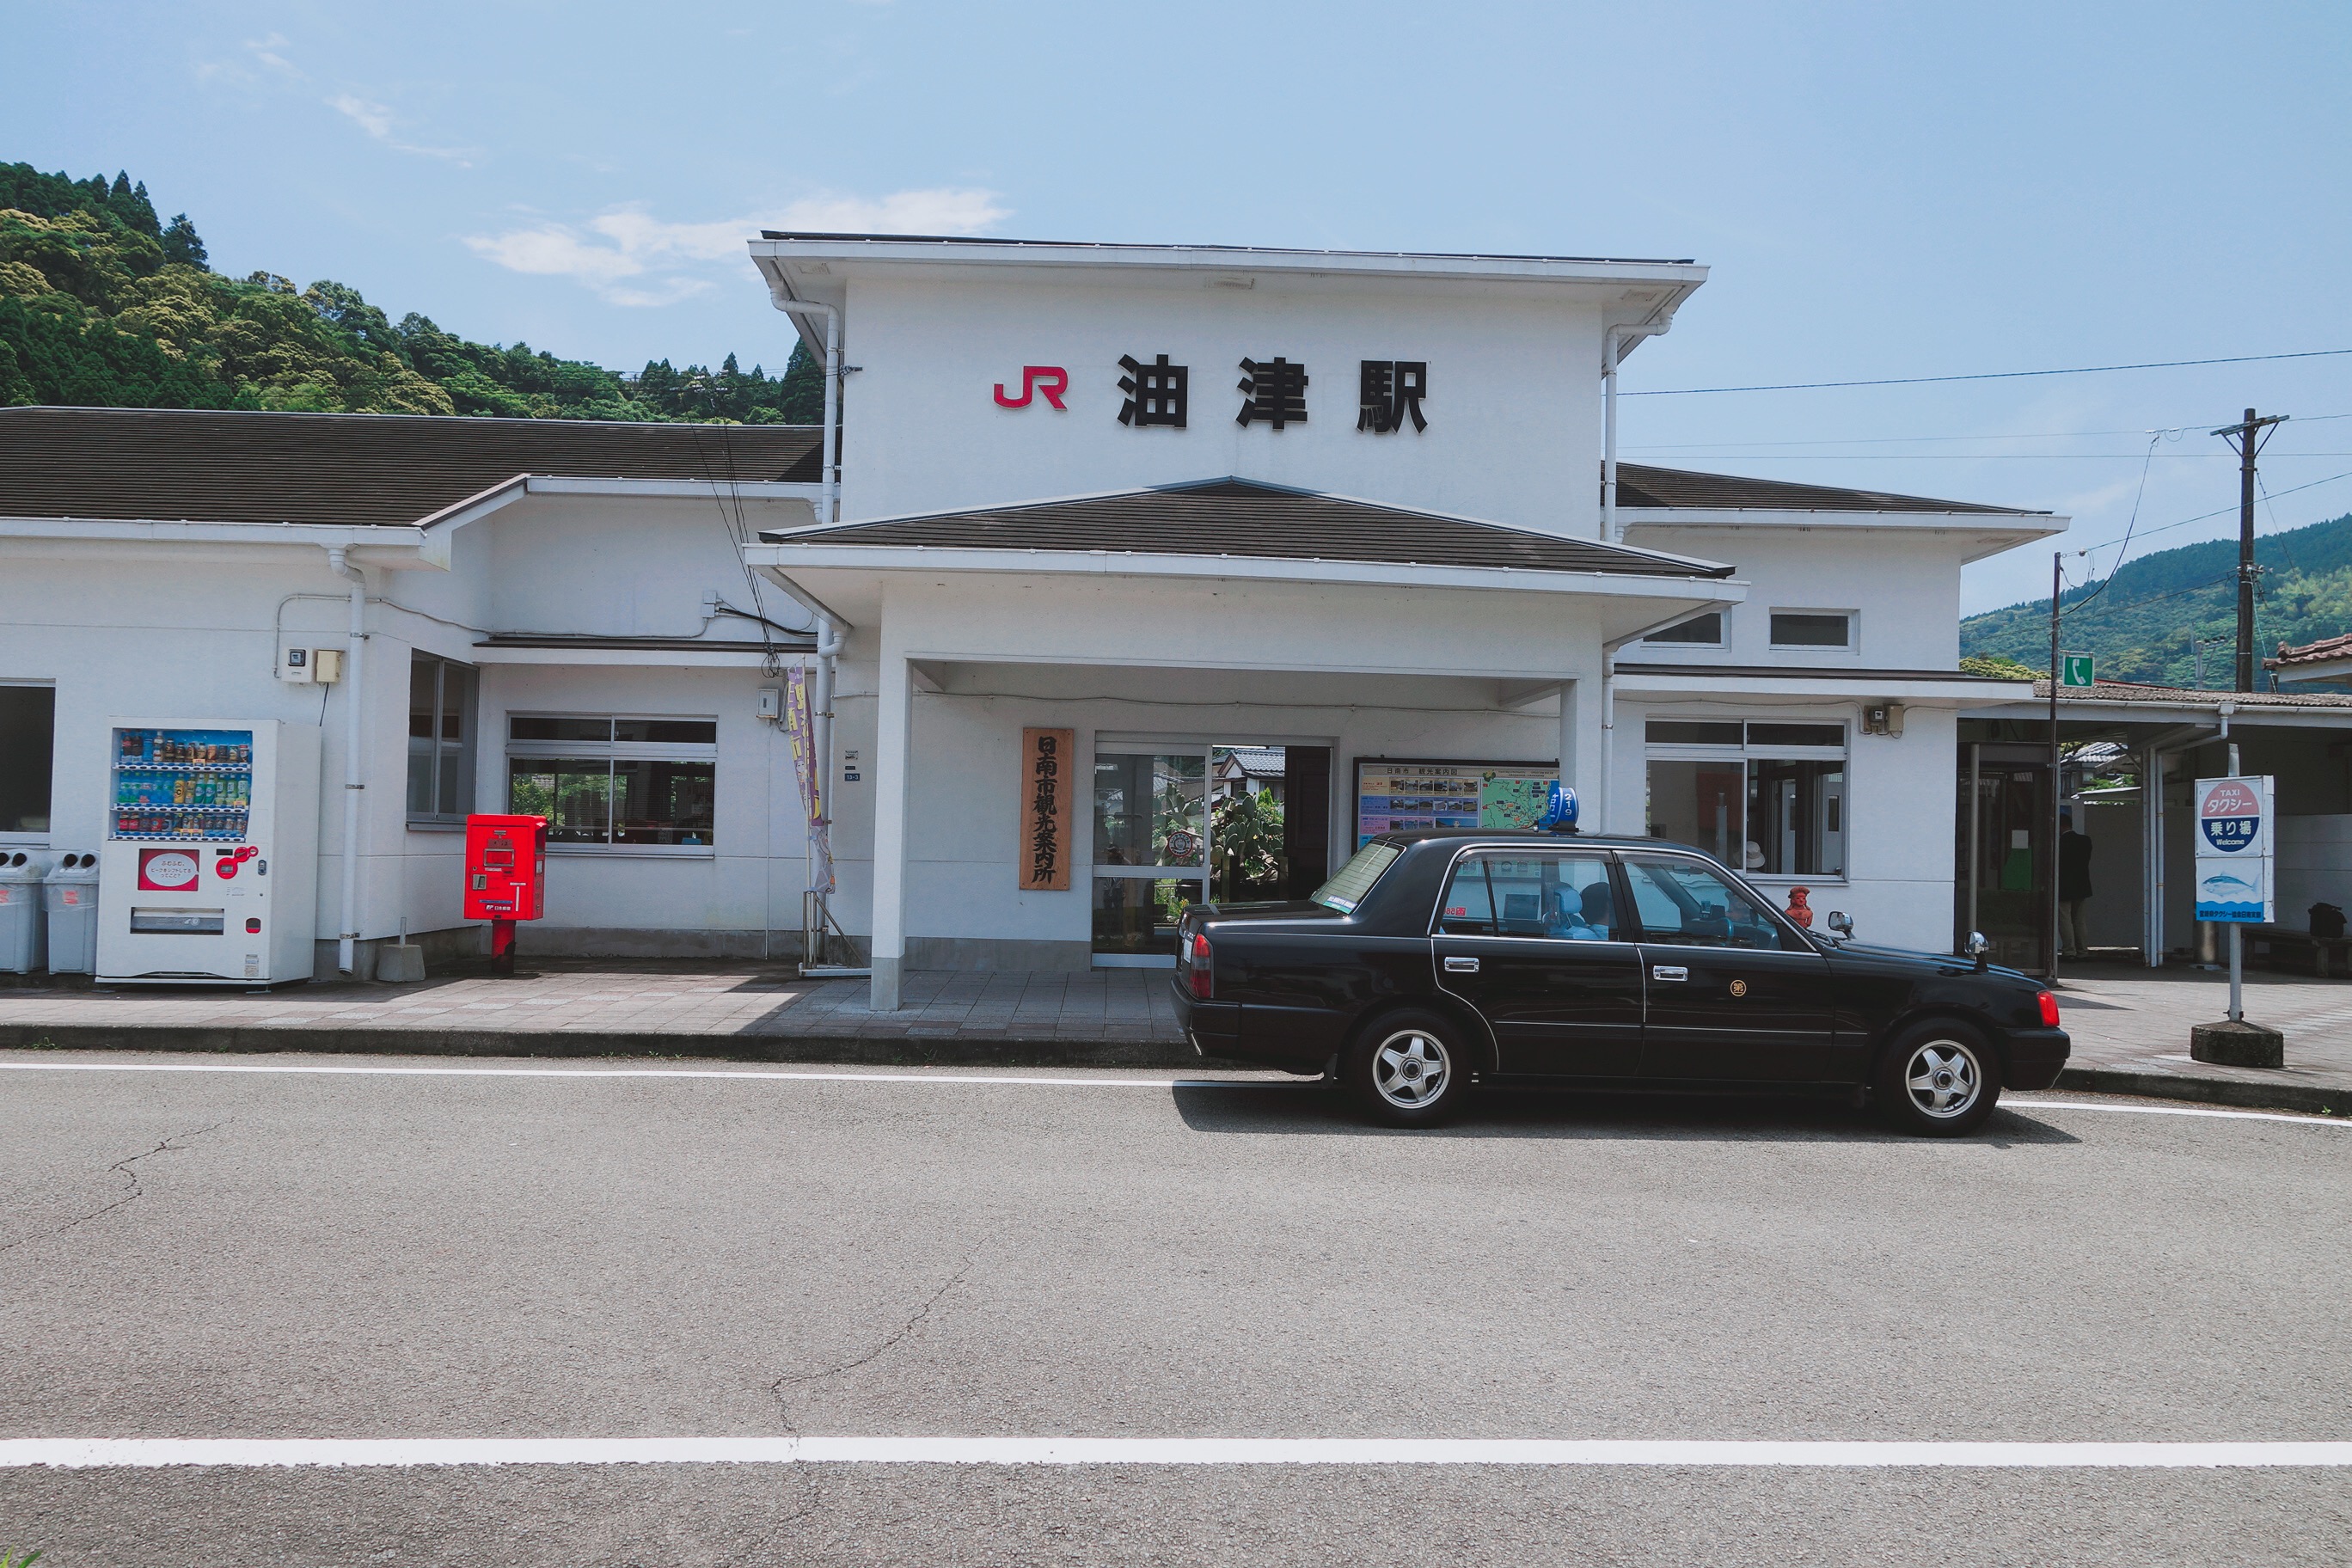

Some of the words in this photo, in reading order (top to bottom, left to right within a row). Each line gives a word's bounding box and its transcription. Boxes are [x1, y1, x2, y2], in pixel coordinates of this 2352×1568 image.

[994, 366, 1069, 410] JR
[1117, 353, 1429, 434] 油津駅
[1032, 736, 1057, 885] 日南市観光案内所
[2208, 798, 2252, 813] タクシー
[2210, 821, 2251, 836] 乗り場
